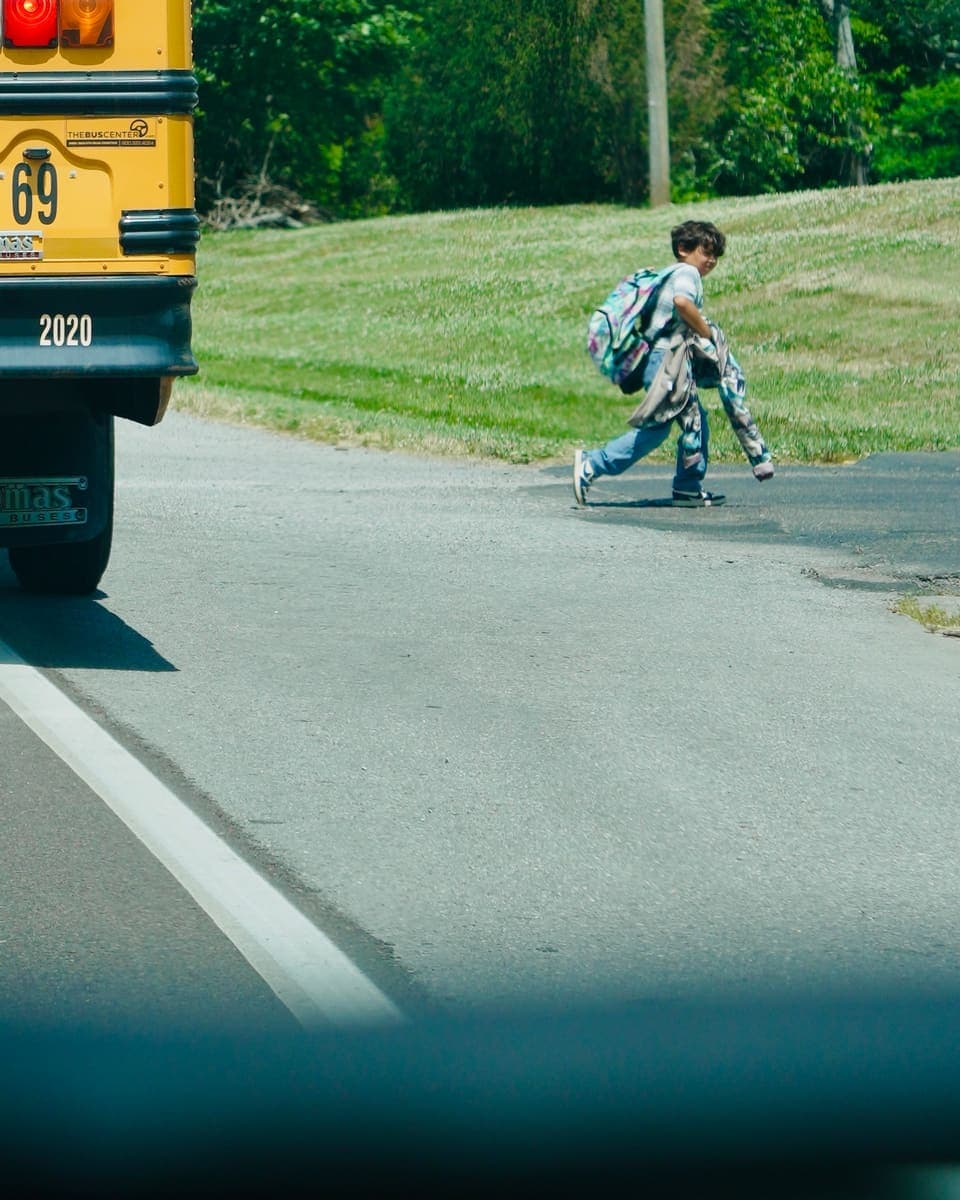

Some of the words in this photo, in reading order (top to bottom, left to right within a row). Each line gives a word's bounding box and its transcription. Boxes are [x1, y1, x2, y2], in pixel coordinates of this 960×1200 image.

[12, 162, 58, 225] 69
[40, 314, 92, 346] 2020
[9, 512, 73, 523] BUSES
